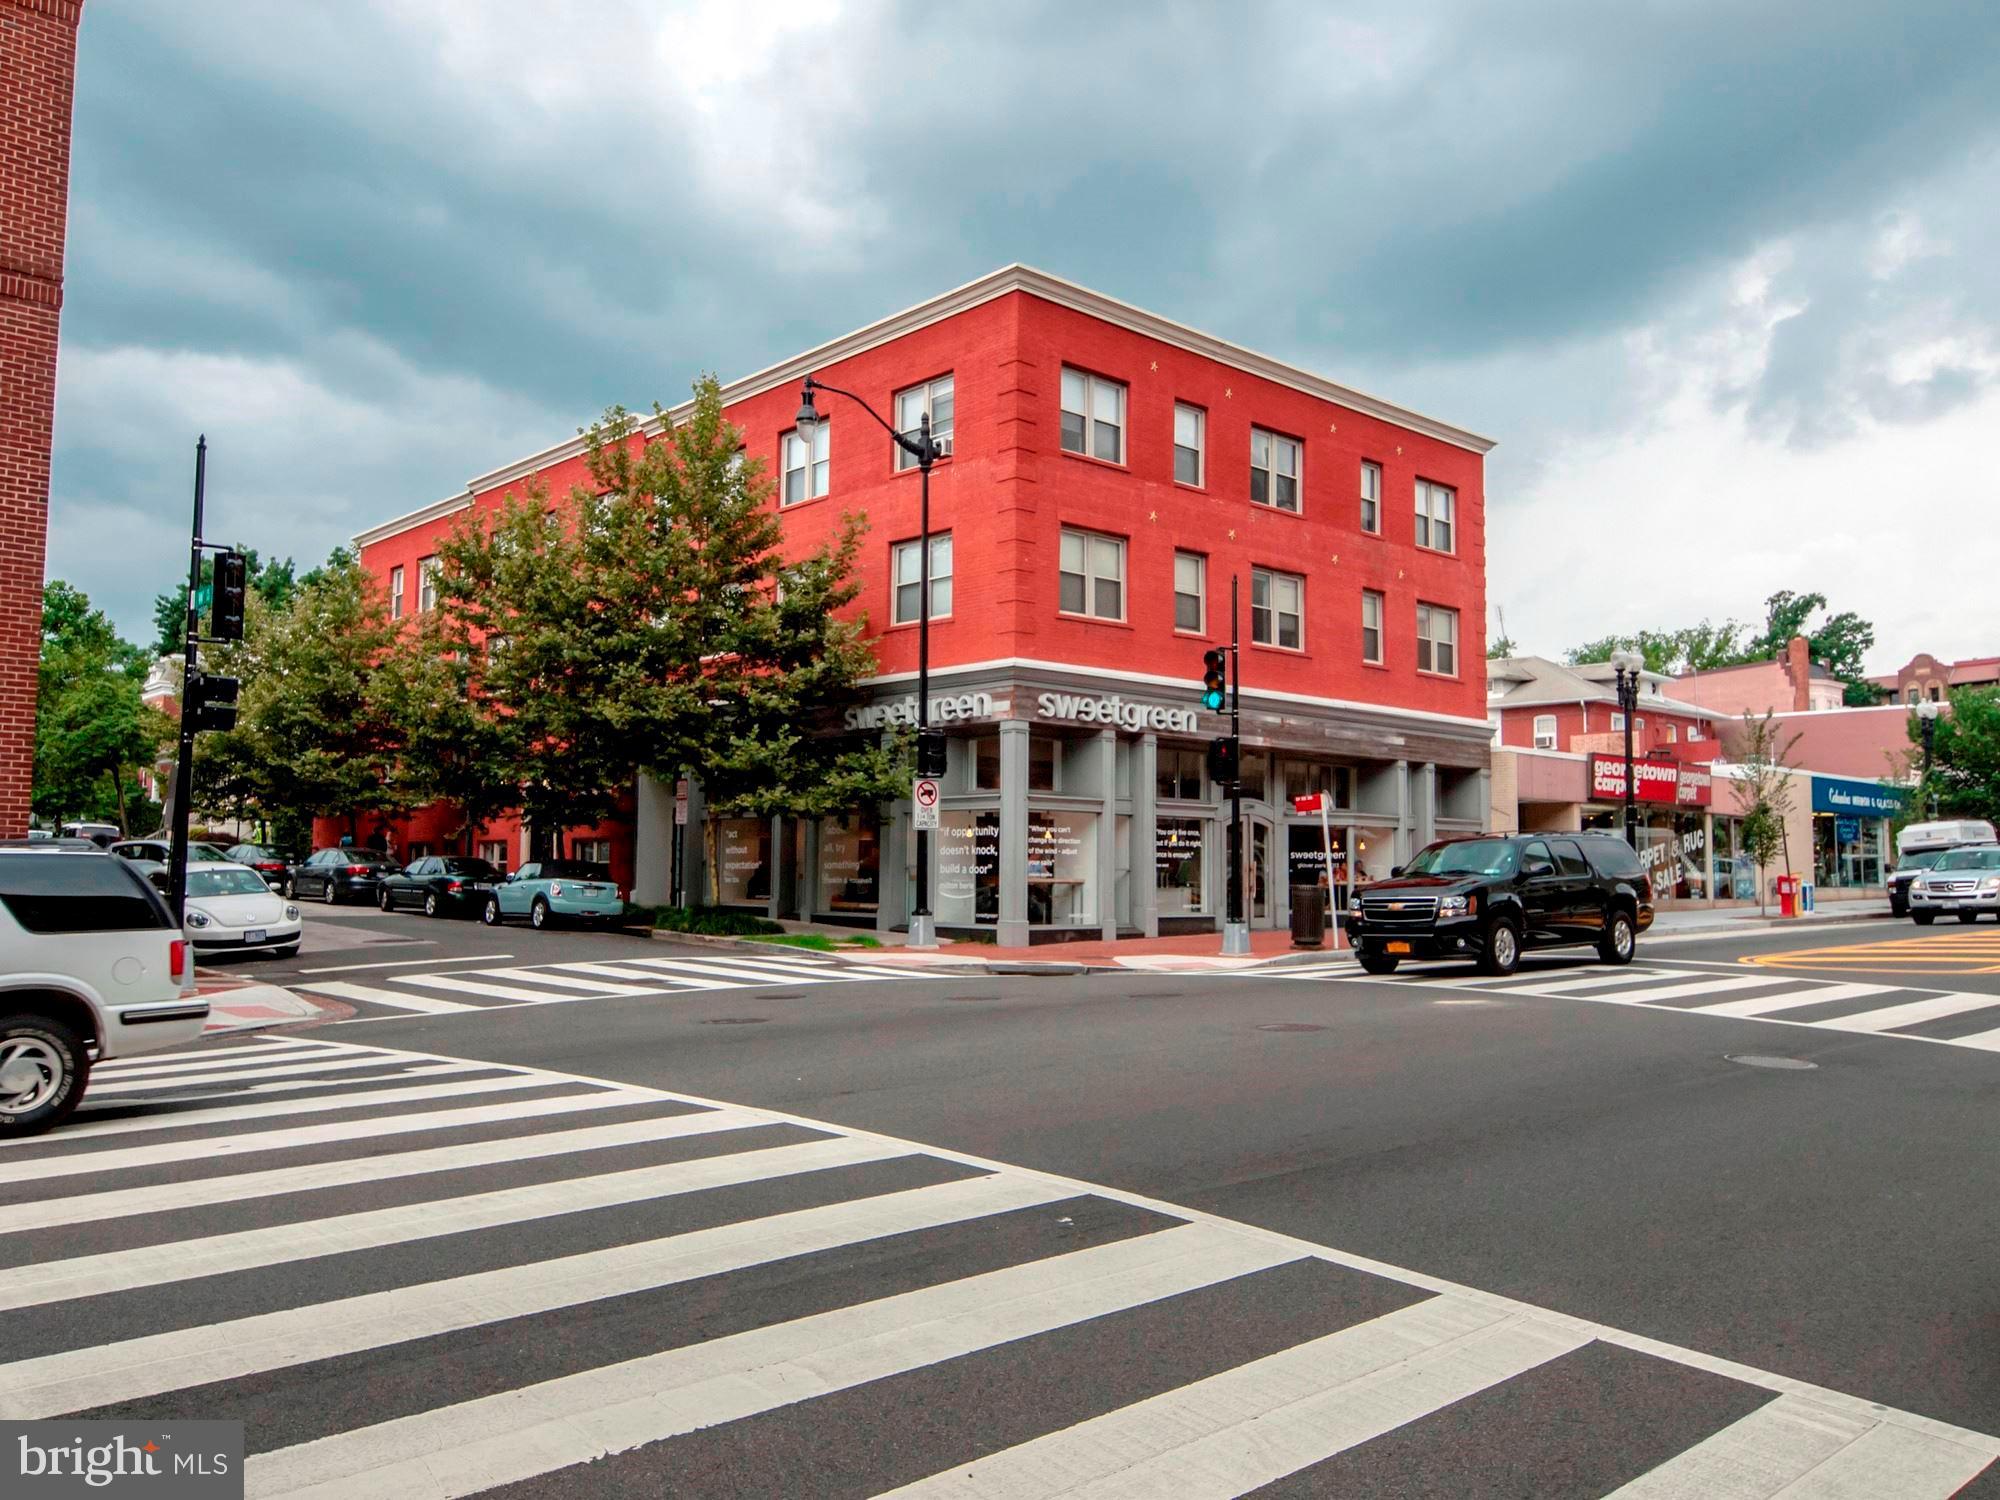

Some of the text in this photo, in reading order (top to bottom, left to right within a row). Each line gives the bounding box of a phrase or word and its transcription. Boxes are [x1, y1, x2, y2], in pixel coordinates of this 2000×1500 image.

[1038, 693, 1198, 732] sweetgreen
[1594, 760, 1677, 782] georetown
[1594, 776, 1640, 795] carpt
[951, 826, 999, 838] opprtunity
[940, 844, 998, 856] doesn't knock,
[1290, 851, 1346, 860] sweetgren
[1640, 843, 1665, 870] RPET
[1683, 829, 1704, 854] RUG
[940, 863, 993, 874] build a door"
[1656, 863, 1683, 891] SALE
